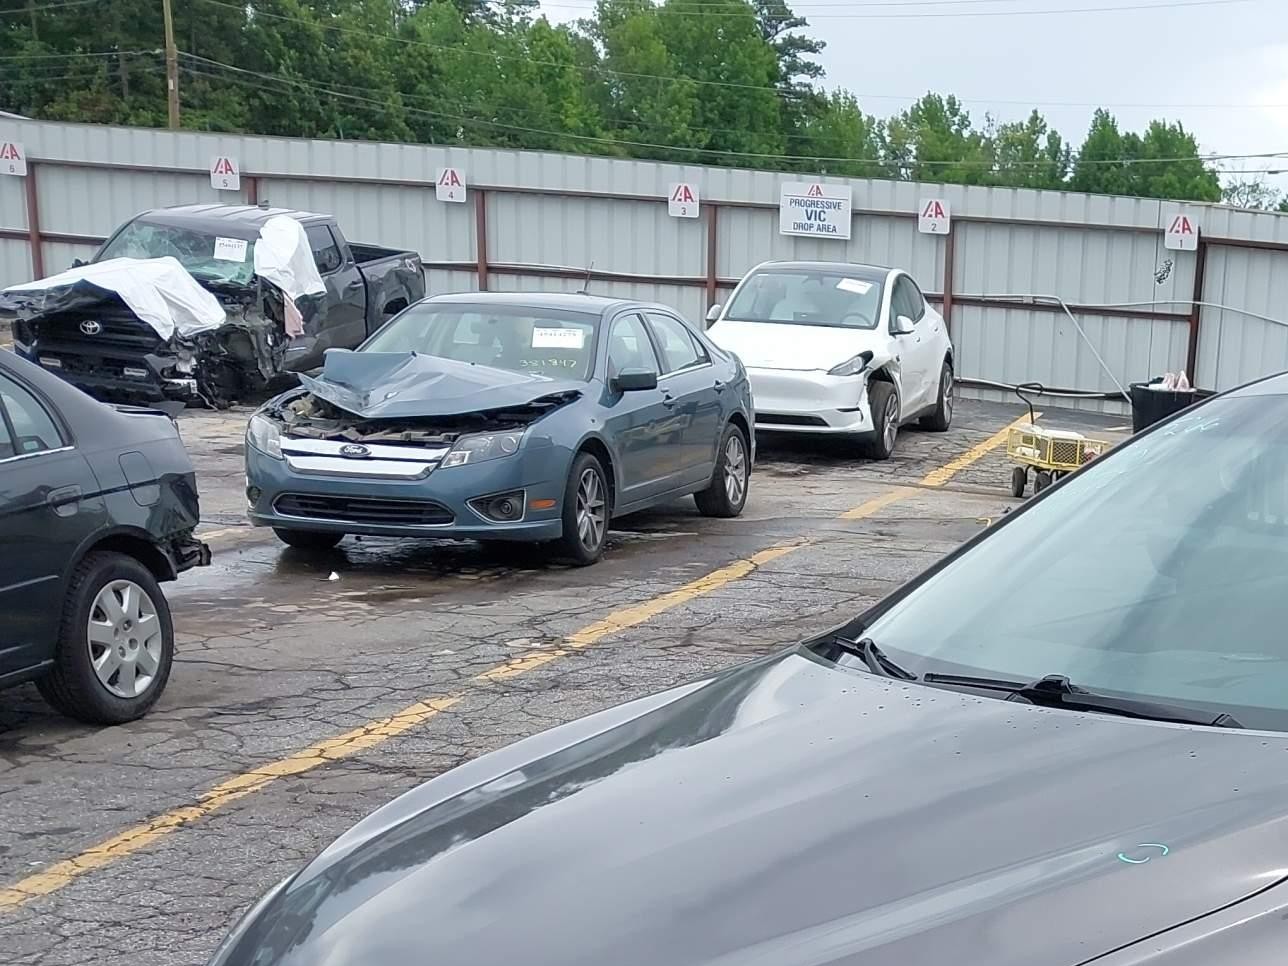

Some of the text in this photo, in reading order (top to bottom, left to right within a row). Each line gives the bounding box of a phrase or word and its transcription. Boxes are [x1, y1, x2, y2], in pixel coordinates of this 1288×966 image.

[789, 198, 842, 210] PROGRESSIVE
[681, 207, 687, 215] 3
[805, 208, 827, 222] VIC
[792, 221, 837, 233] DROP AREA
[931, 223, 937, 231] 2
